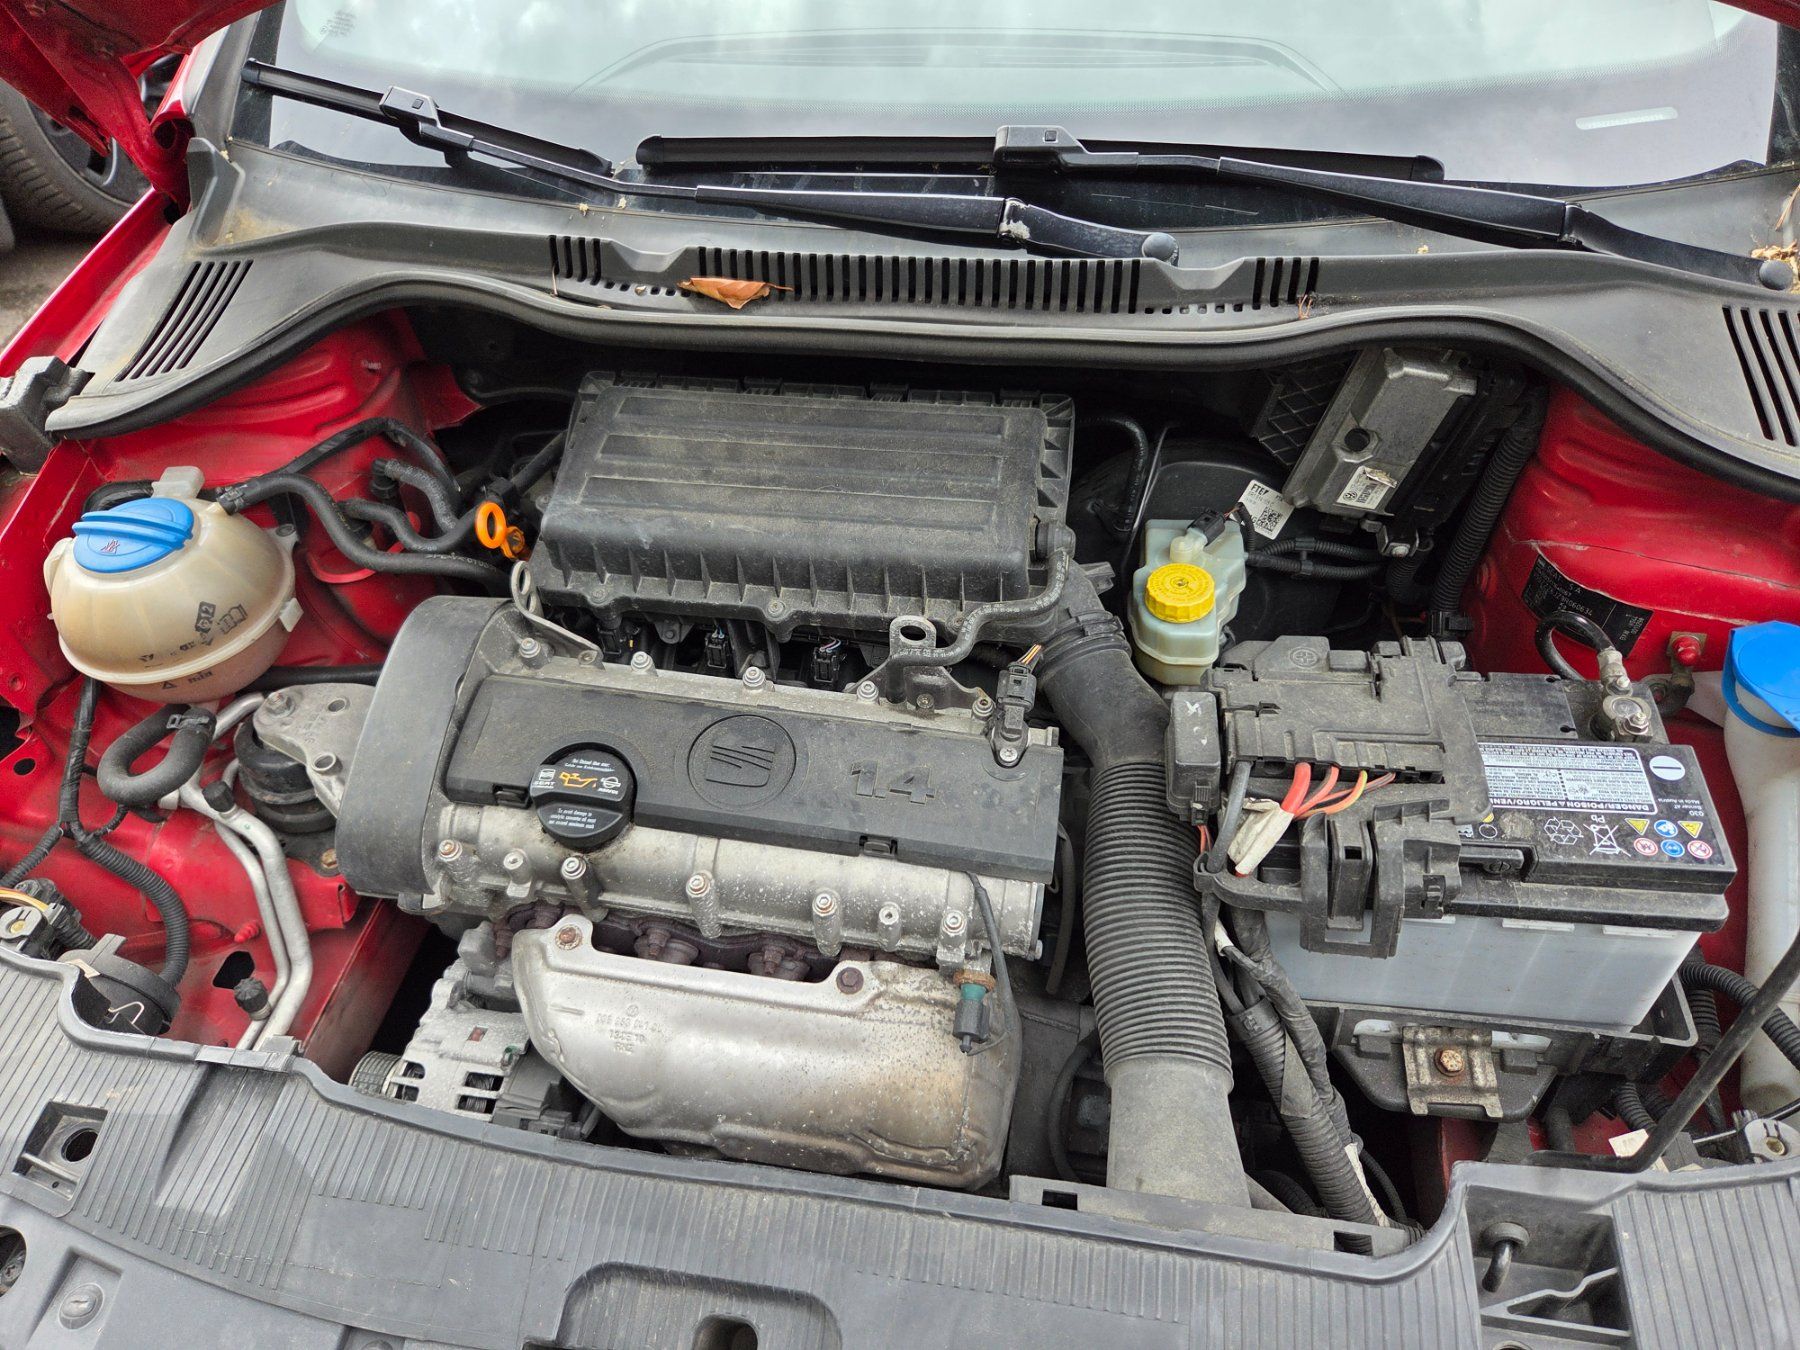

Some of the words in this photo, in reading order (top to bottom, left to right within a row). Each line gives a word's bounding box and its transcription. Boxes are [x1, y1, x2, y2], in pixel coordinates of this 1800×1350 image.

[1250, 483, 1264, 495] FTE
[188, 671, 213, 683] min
[851, 760, 935, 805] 1.4
[1591, 814, 1605, 823] Pb
